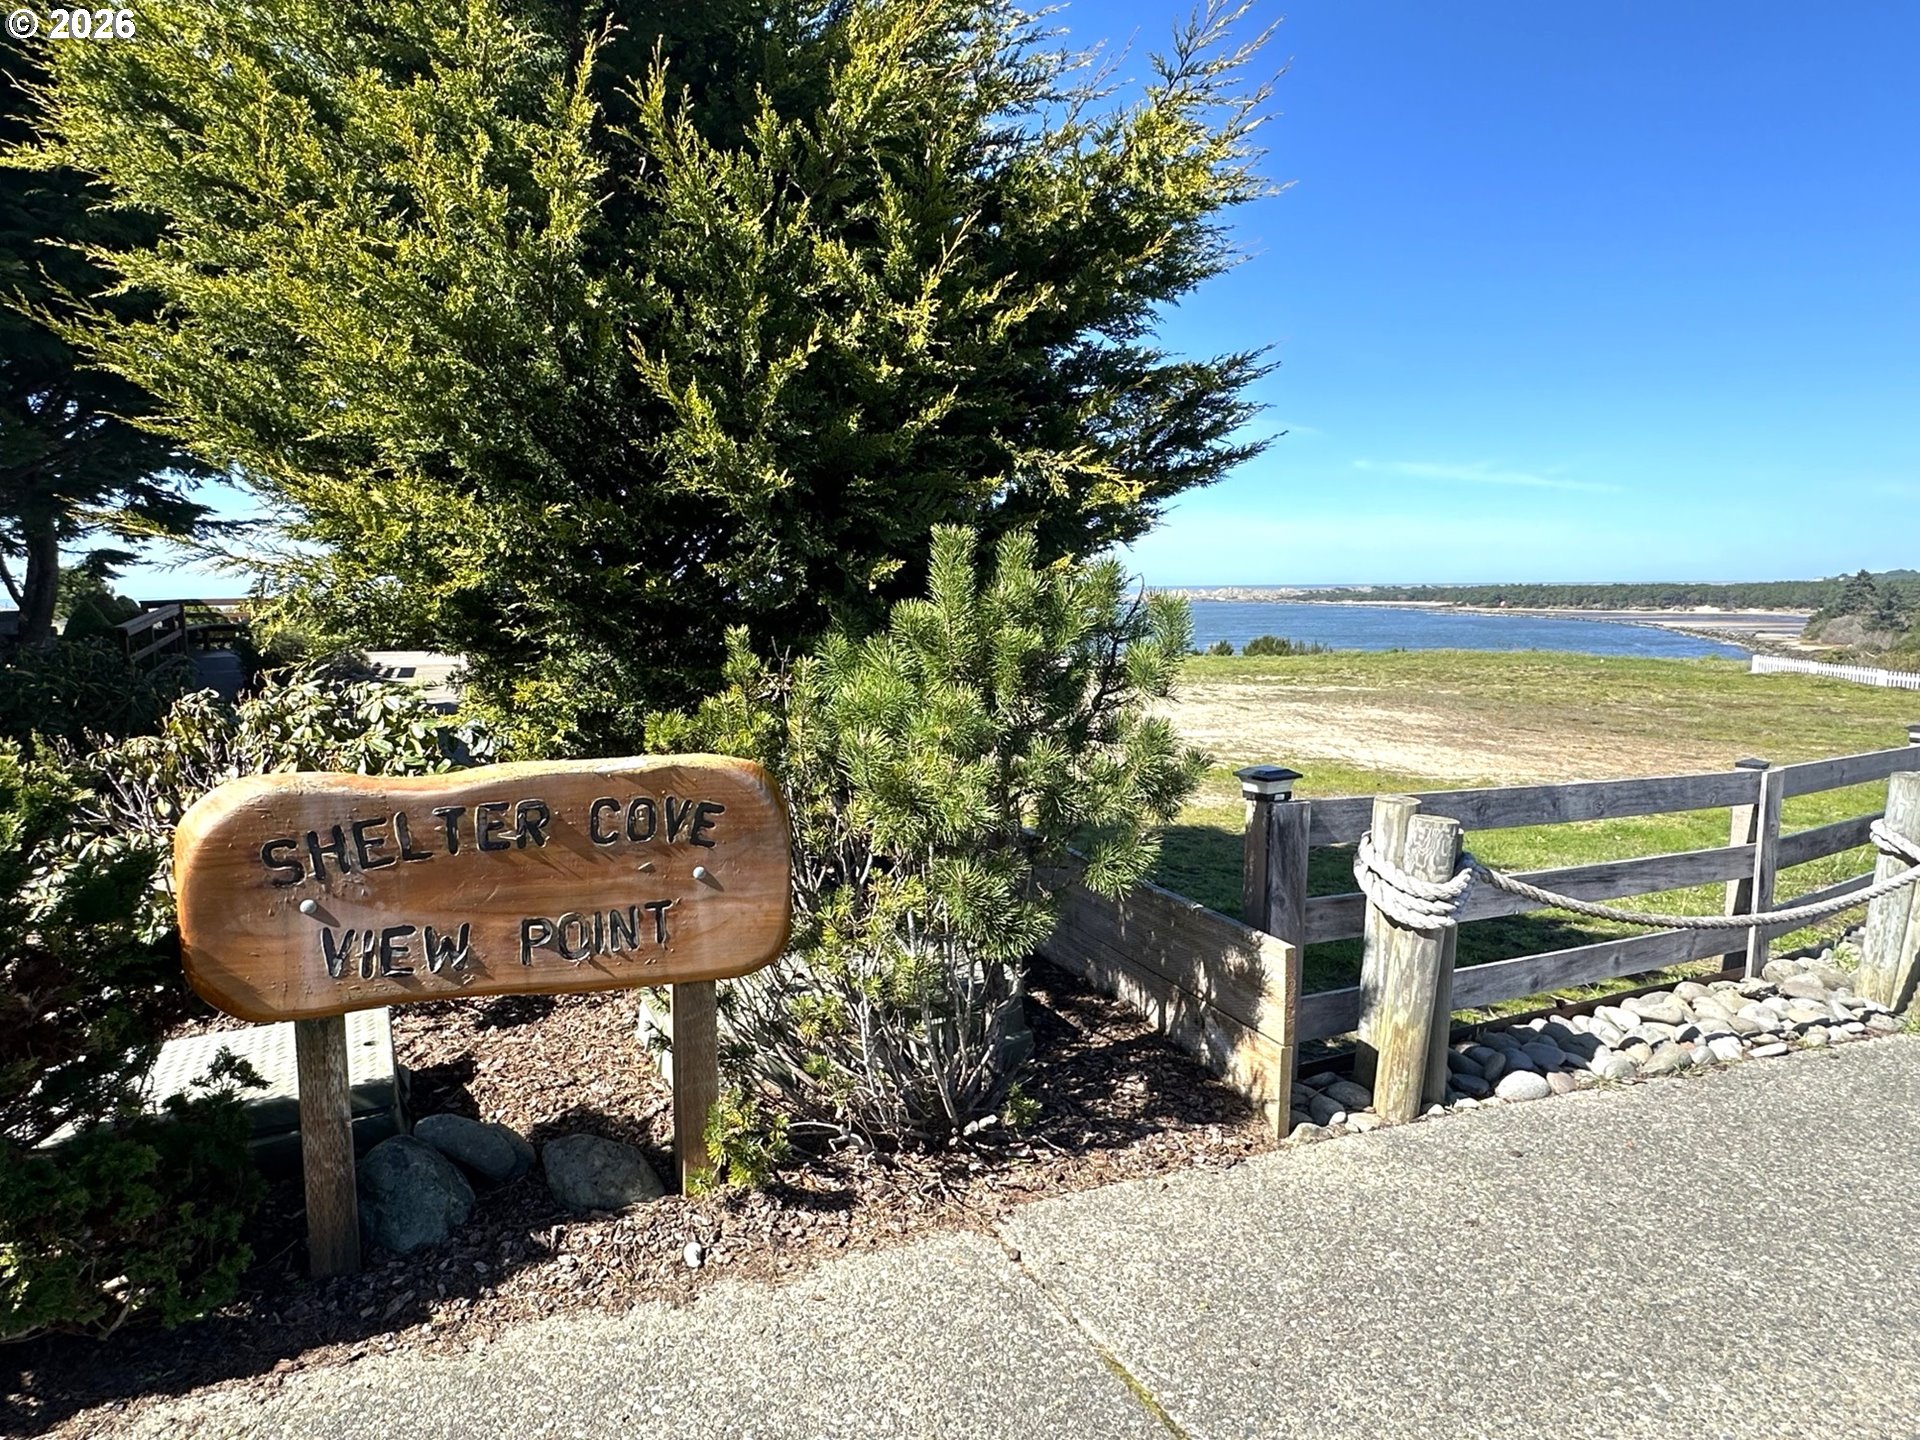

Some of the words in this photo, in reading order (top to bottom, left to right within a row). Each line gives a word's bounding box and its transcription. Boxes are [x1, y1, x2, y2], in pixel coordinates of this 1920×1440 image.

[260, 798, 550, 887] SHELTER
[590, 796, 726, 849] COVE
[321, 922, 470, 979] VIEW
[520, 899, 673, 966] POINT
